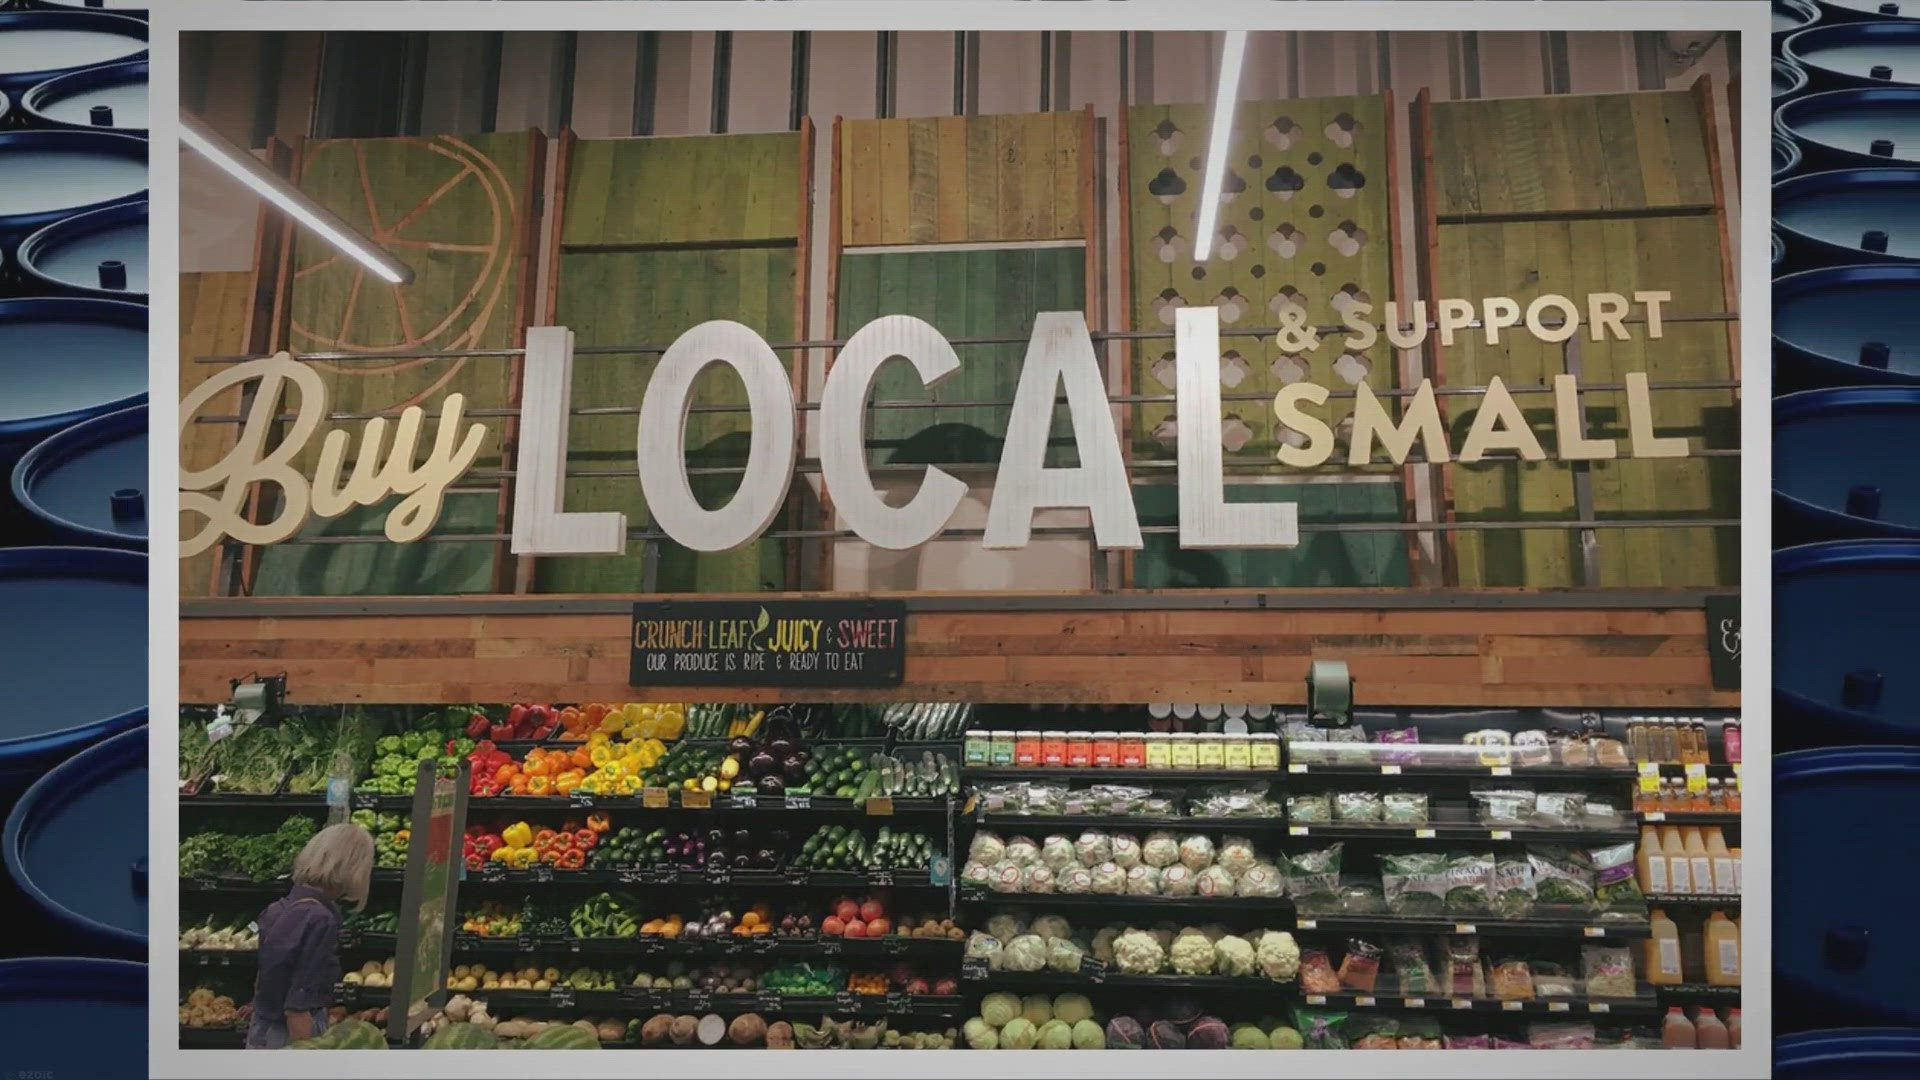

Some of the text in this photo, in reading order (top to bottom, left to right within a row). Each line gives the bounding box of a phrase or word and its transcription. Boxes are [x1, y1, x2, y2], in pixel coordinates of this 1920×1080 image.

[1276, 290, 1672, 353] & SUPPORT
[178, 305, 1300, 559] Buy LOCAL
[1273, 371, 1691, 468] SMALL
[646, 652, 667, 672] OUR
[673, 652, 721, 671] PRODUCE
[725, 652, 737, 671] IS
[743, 652, 766, 671] RIPE
[789, 652, 821, 671] READY
[825, 652, 840, 671] TO
[844, 652, 865, 671] EAT
[768, 618, 823, 652] JUICY
[826, 626, 833, 644] &
[837, 618, 898, 649] SWEET
